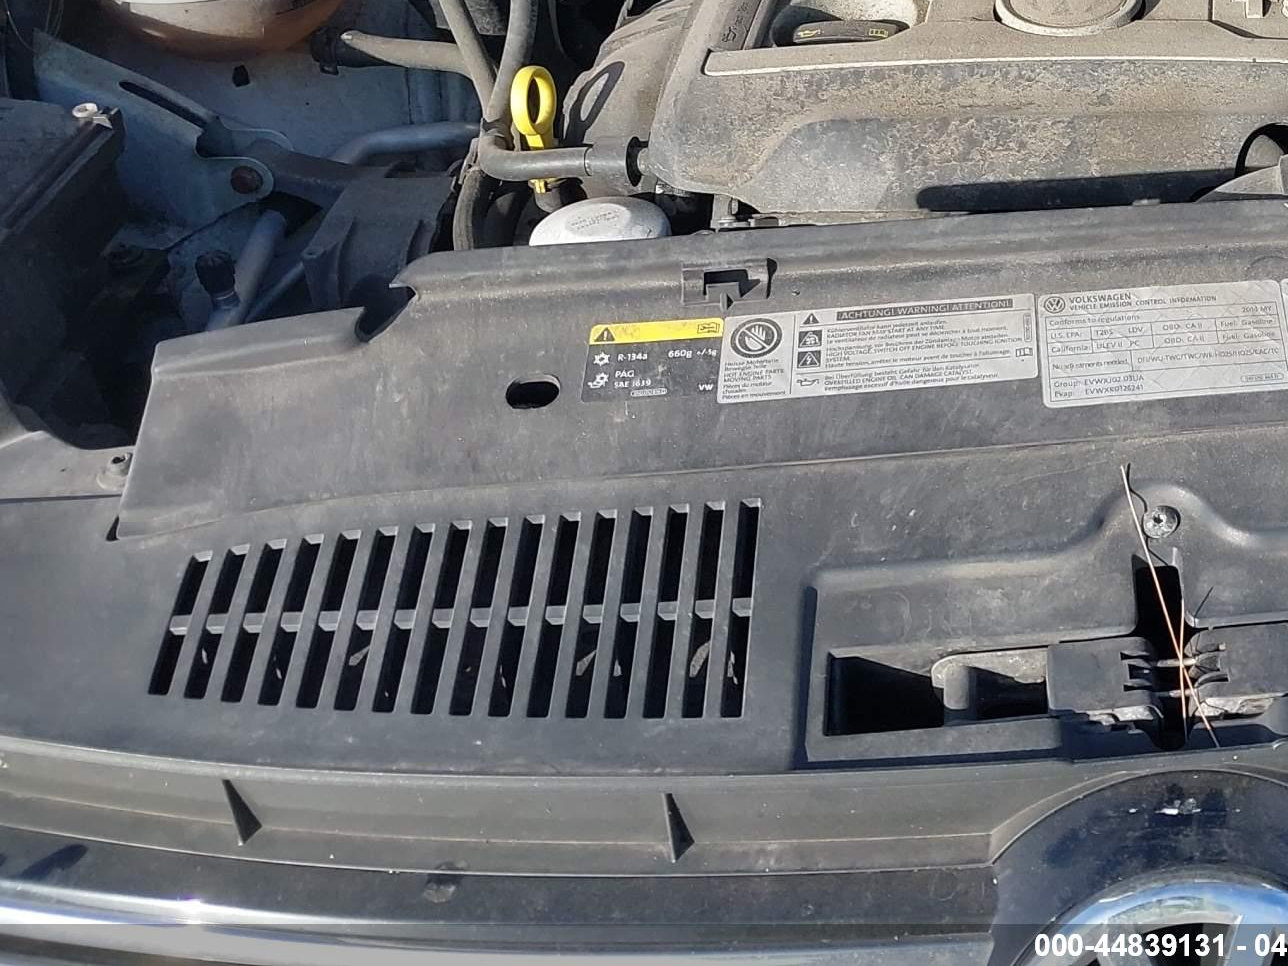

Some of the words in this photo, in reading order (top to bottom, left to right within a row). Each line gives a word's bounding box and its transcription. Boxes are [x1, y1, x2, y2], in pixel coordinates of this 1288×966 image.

[1069, 293, 1132, 304] VOLKSWAGEN
[1069, 303, 1097, 311] VEHICLE
[1099, 300, 1133, 309] EMISSION
[1135, 298, 1166, 306] CONTROL
[1169, 295, 1217, 304] INFORMATION
[1049, 318, 1086, 327] Conforms
[1097, 314, 1140, 323] regulations
[617, 352, 648, 362] R-134a
[667, 349, 693, 359] 660g
[615, 369, 635, 378] PAG
